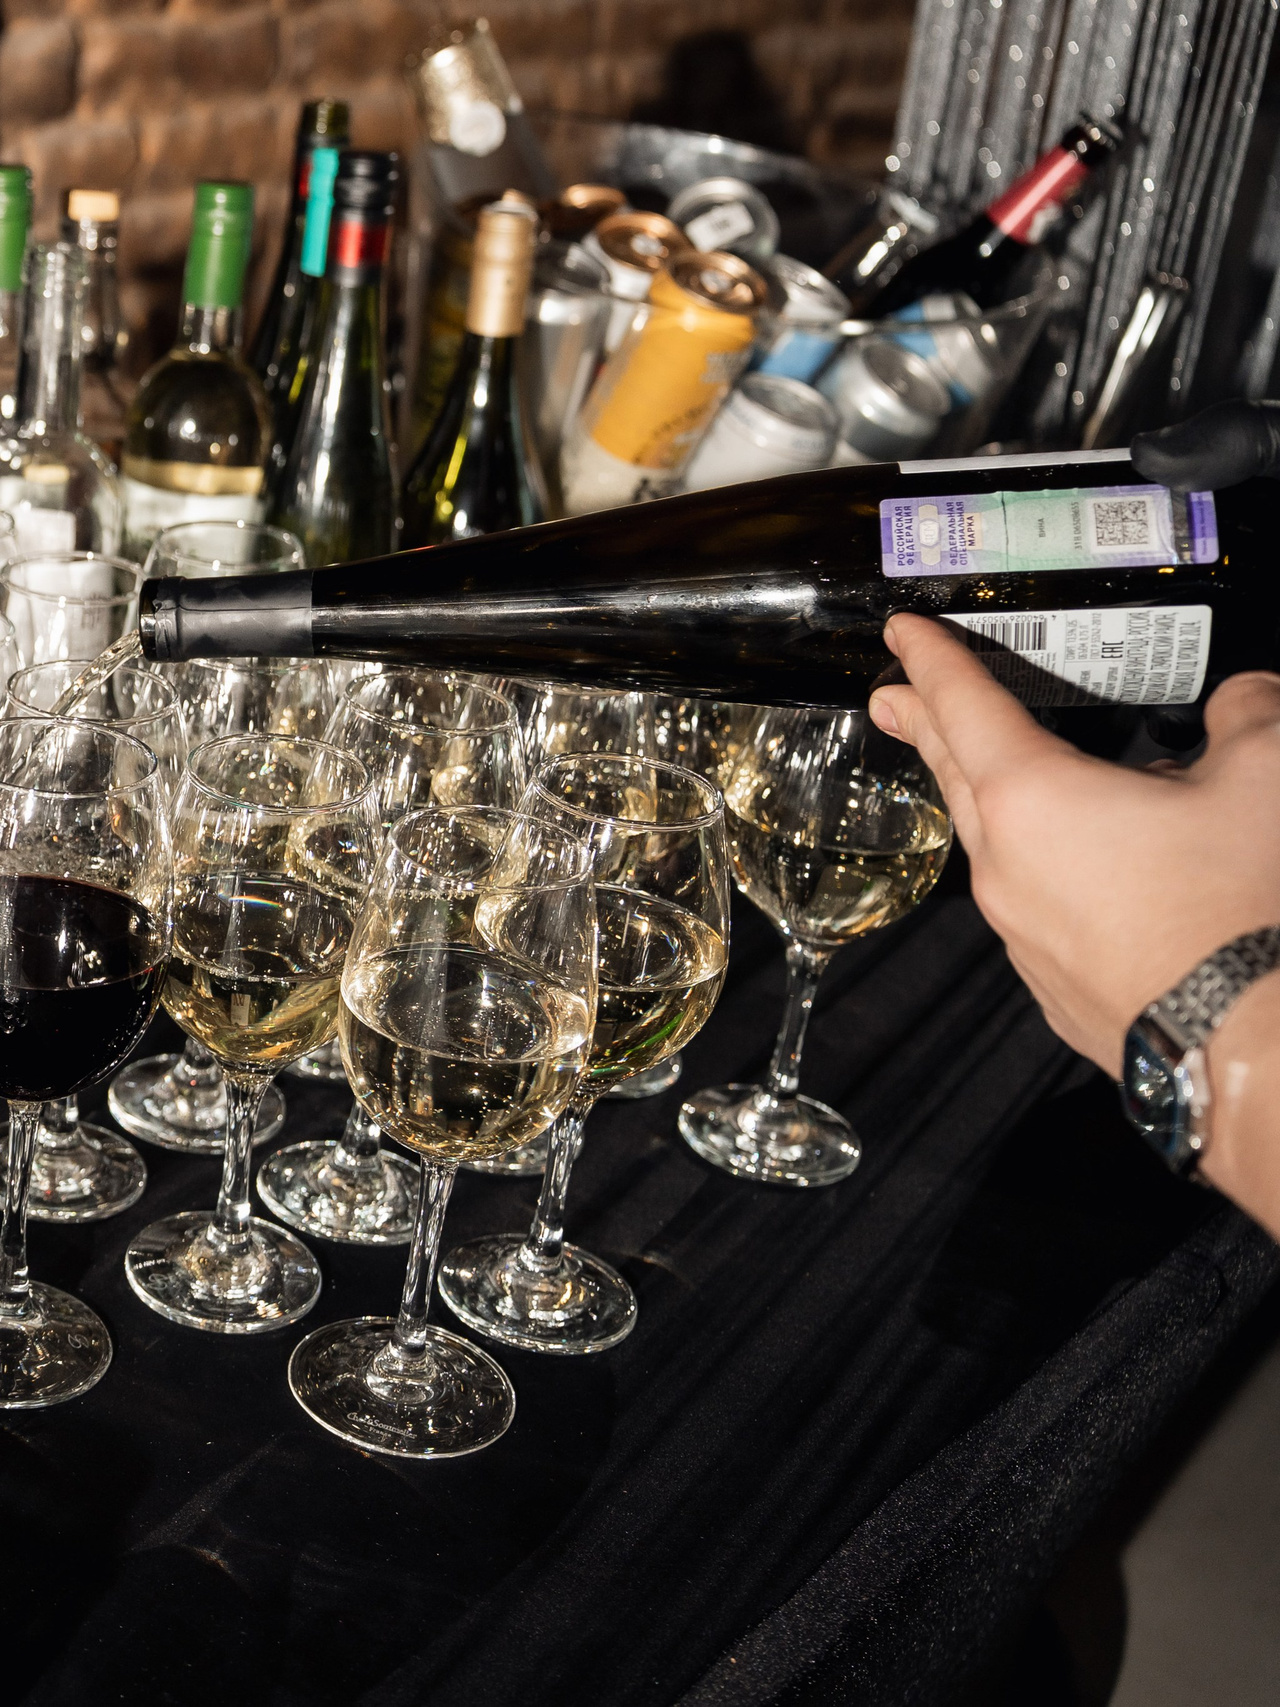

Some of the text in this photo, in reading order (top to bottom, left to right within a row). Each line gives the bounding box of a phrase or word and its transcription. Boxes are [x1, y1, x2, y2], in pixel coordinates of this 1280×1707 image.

[894, 506, 906, 567] РОССИЙСКАЯ
[904, 505, 915, 566] ФЕДЕРАЦИЯ
[946, 501, 958, 566] ФЕДЕРАЛЬНАЯ
[956, 501, 968, 566] СПЕЦИАЛЬНАЯ
[967, 515, 977, 547] МАРКА
[1036, 517, 1047, 538] ВИНА
[970, 616, 1004, 624] 050571
[1009, 614, 1045, 623] 640026
